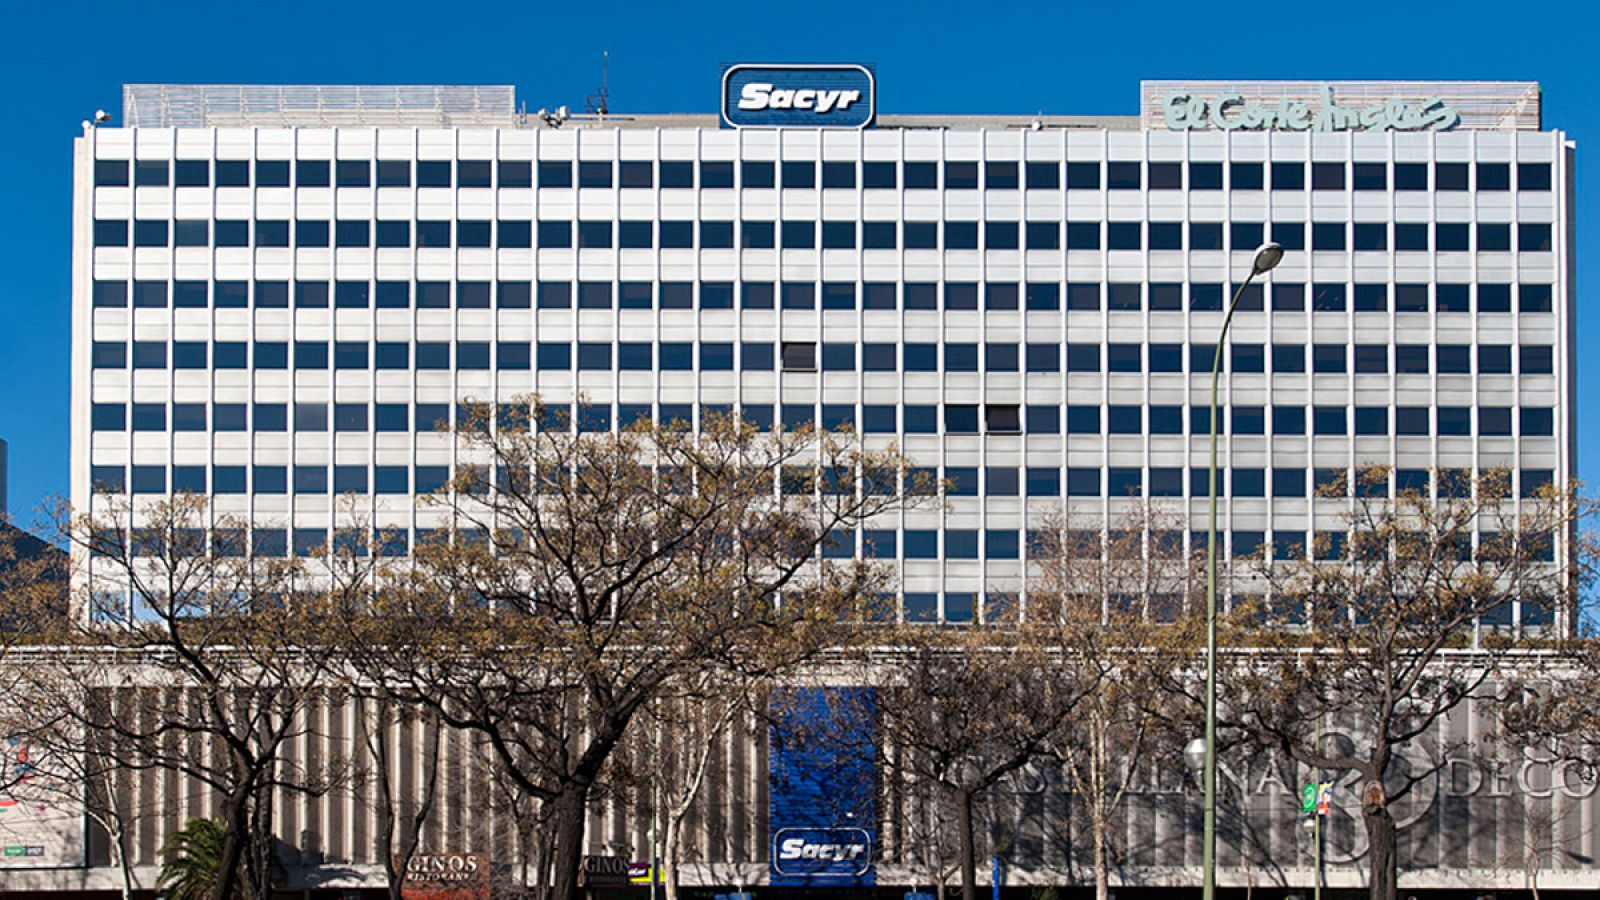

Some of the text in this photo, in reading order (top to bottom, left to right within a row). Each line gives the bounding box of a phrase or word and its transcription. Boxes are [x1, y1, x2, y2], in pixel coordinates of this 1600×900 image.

[738, 83, 860, 113] Sacyr
[1162, 89, 1209, 130] El
[1211, 91, 1312, 131] Corte
[1447, 758, 1598, 797] DECO
[407, 855, 477, 873] GINOS
[779, 838, 865, 861] Sacyr
